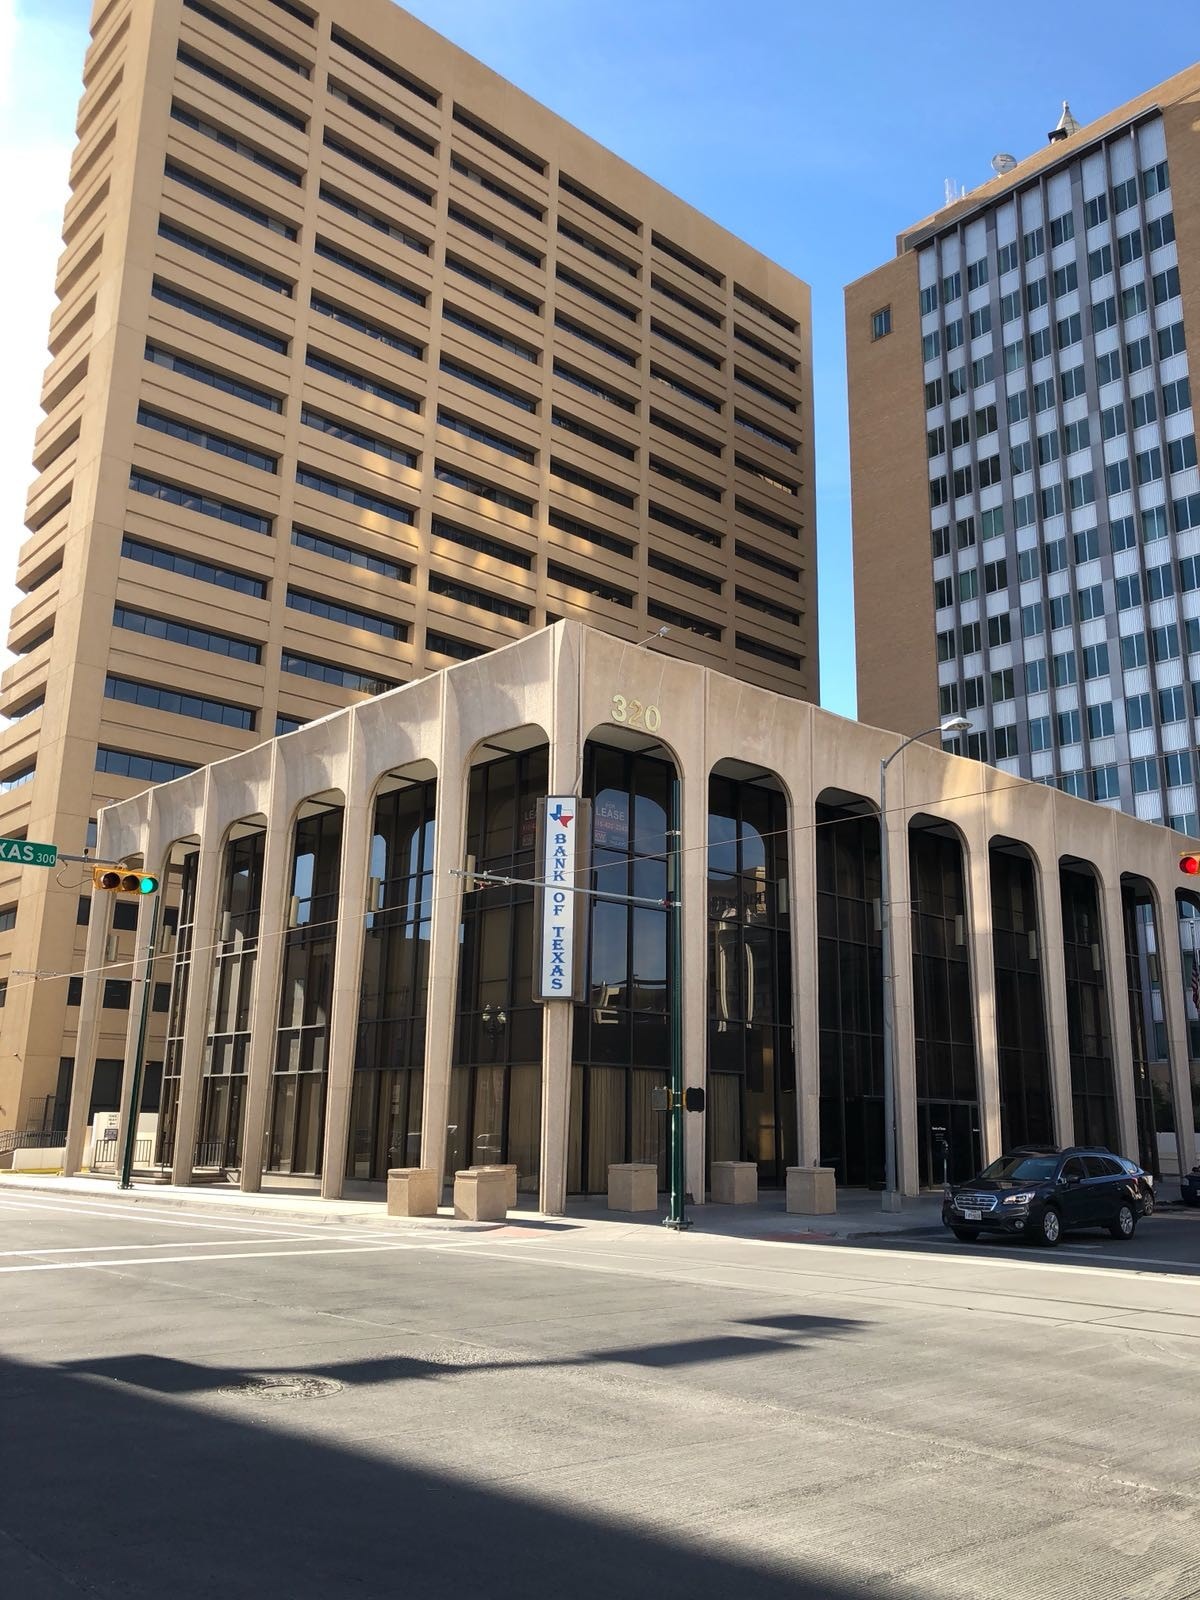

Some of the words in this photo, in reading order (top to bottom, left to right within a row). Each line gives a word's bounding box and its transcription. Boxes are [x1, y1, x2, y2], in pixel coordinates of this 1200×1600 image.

[611, 694, 661, 732] 320
[595, 806, 625, 821] LEASE
[36, 853, 55, 864] 300
[553, 833, 567, 881] BANK
[553, 892, 565, 916] OF
[550, 926, 565, 990] TEXAS
